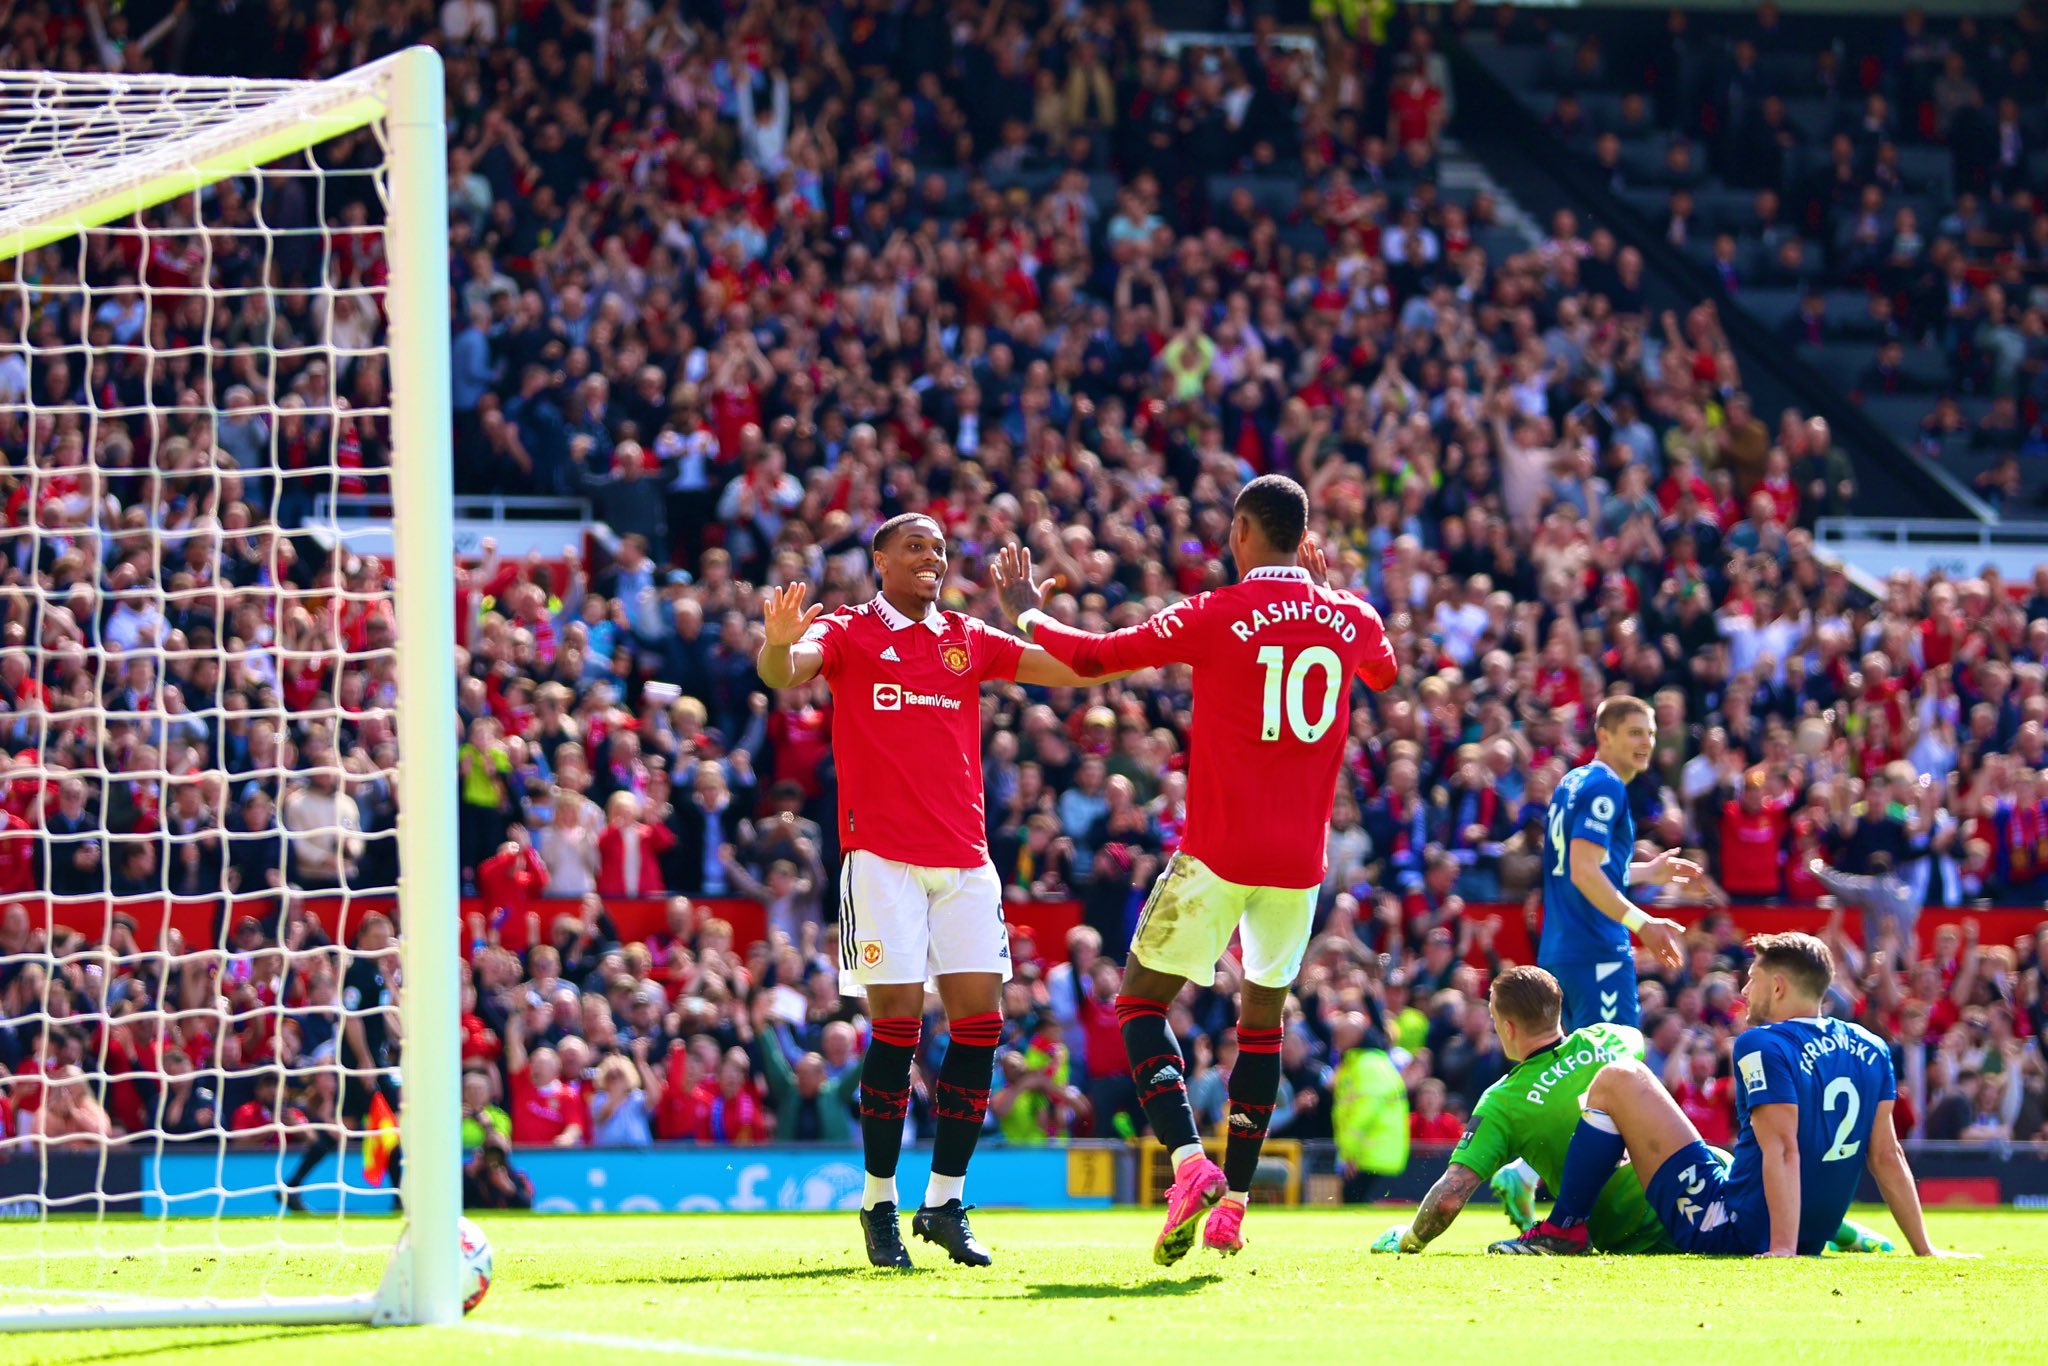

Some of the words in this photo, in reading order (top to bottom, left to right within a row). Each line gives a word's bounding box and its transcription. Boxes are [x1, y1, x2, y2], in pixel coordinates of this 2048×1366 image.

[1230, 600, 1357, 643] RASHFORD
[902, 691, 961, 710] TeamViewr
[1256, 645, 1343, 743] 10
[1526, 1045, 1621, 1105] PICKFORD
[1822, 1076, 1861, 1162] 2
